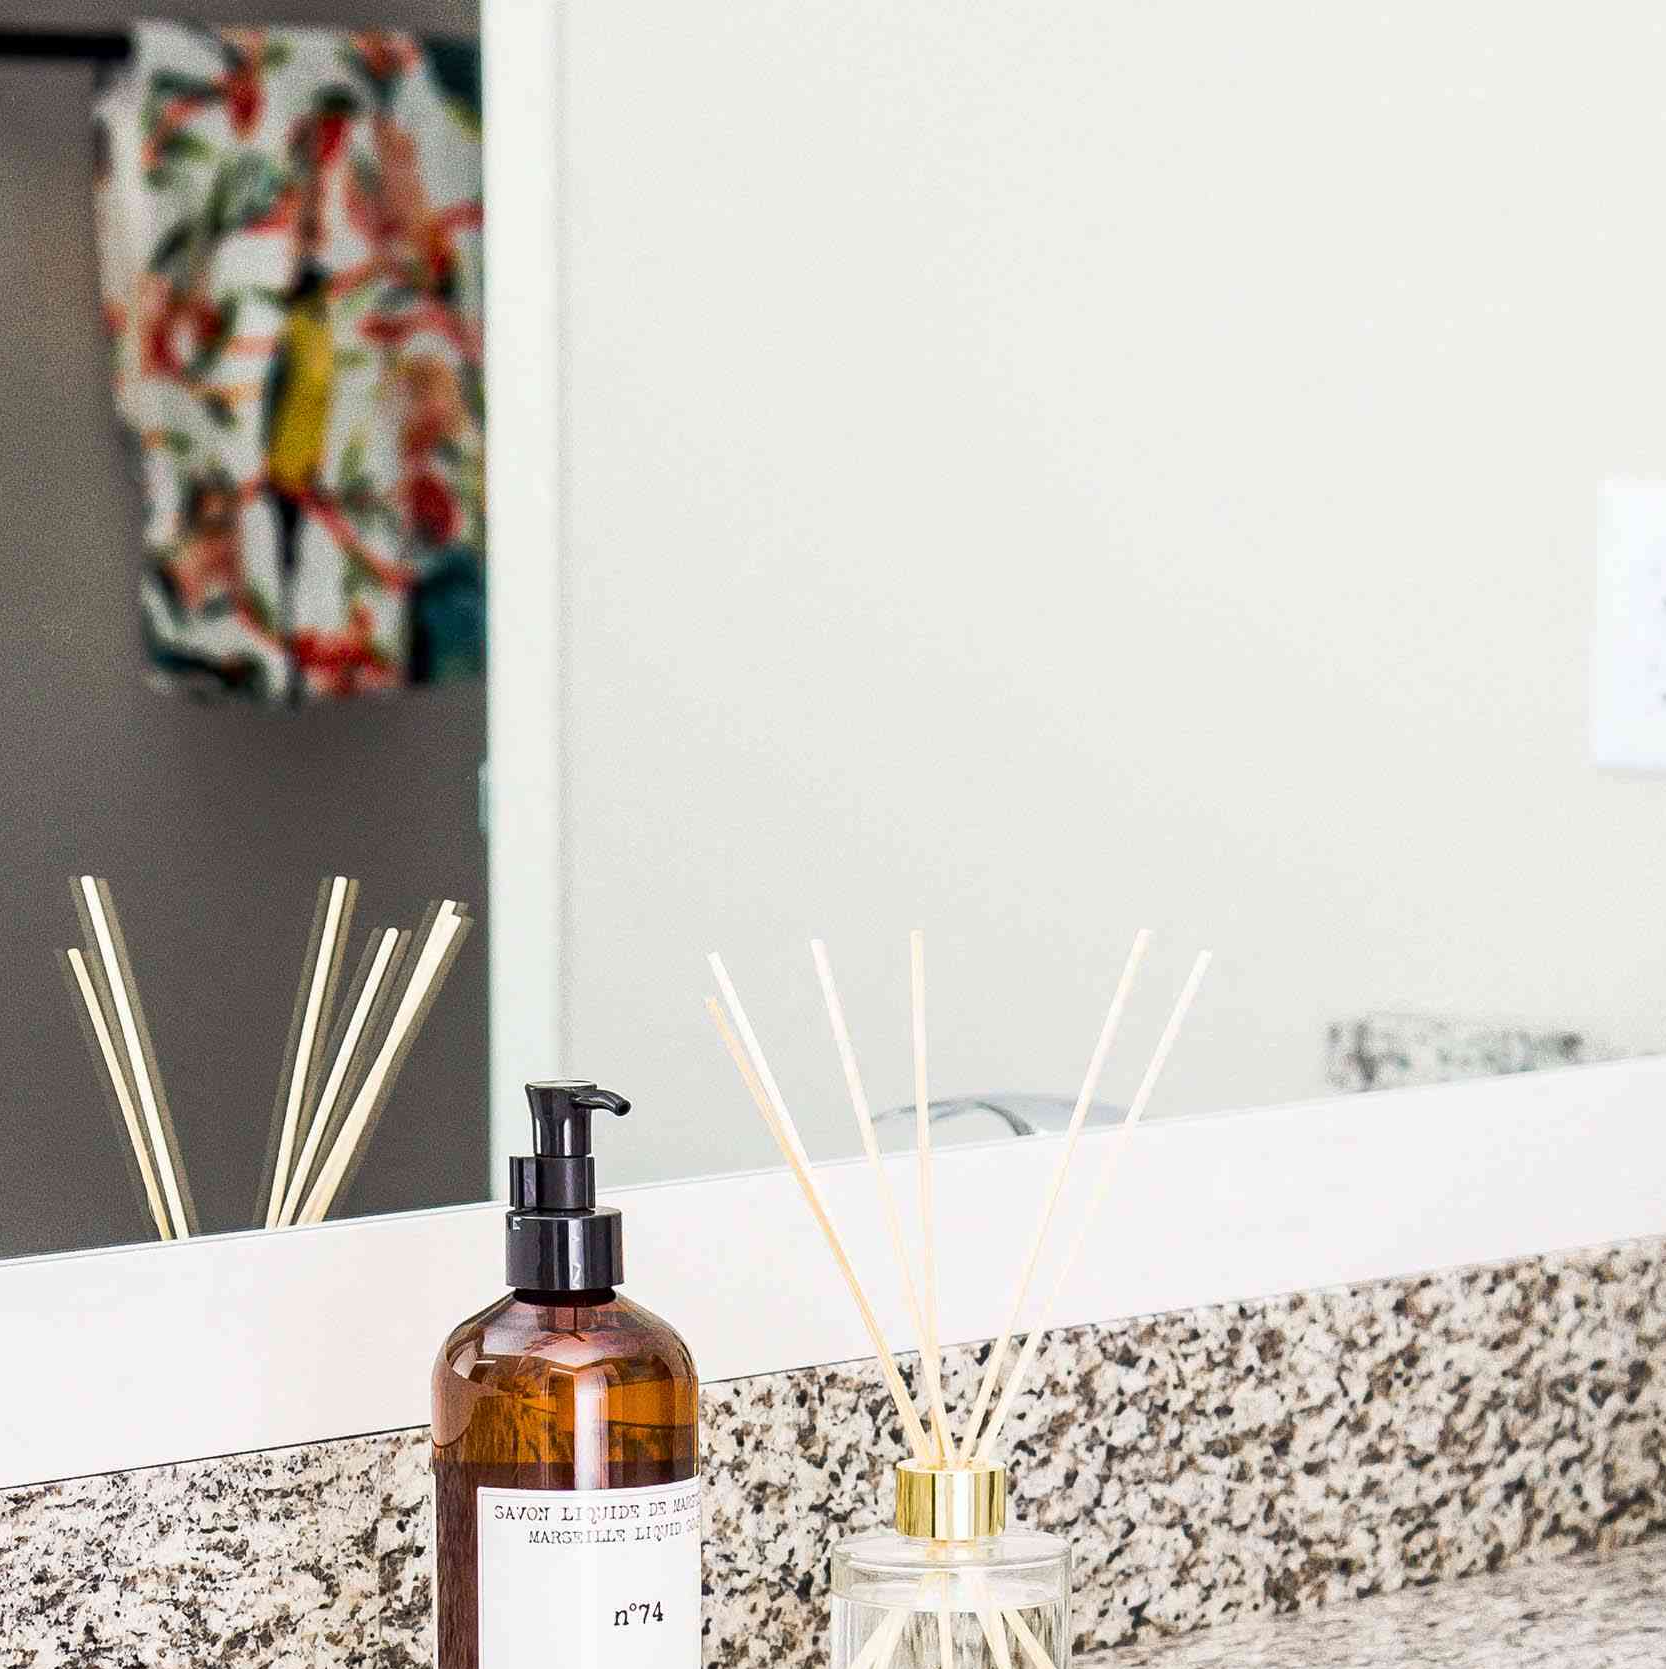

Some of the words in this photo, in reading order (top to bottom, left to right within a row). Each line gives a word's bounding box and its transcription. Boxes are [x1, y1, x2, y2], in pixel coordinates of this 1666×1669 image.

[493, 1505, 550, 1521] SAVON
[560, 1504, 640, 1525] LIQUIDE
[648, 1501, 667, 1517] DE
[528, 1528, 626, 1545] MARSEILLE
[635, 1521, 683, 1542] LIQUID
[613, 1601, 664, 1627] n°74
